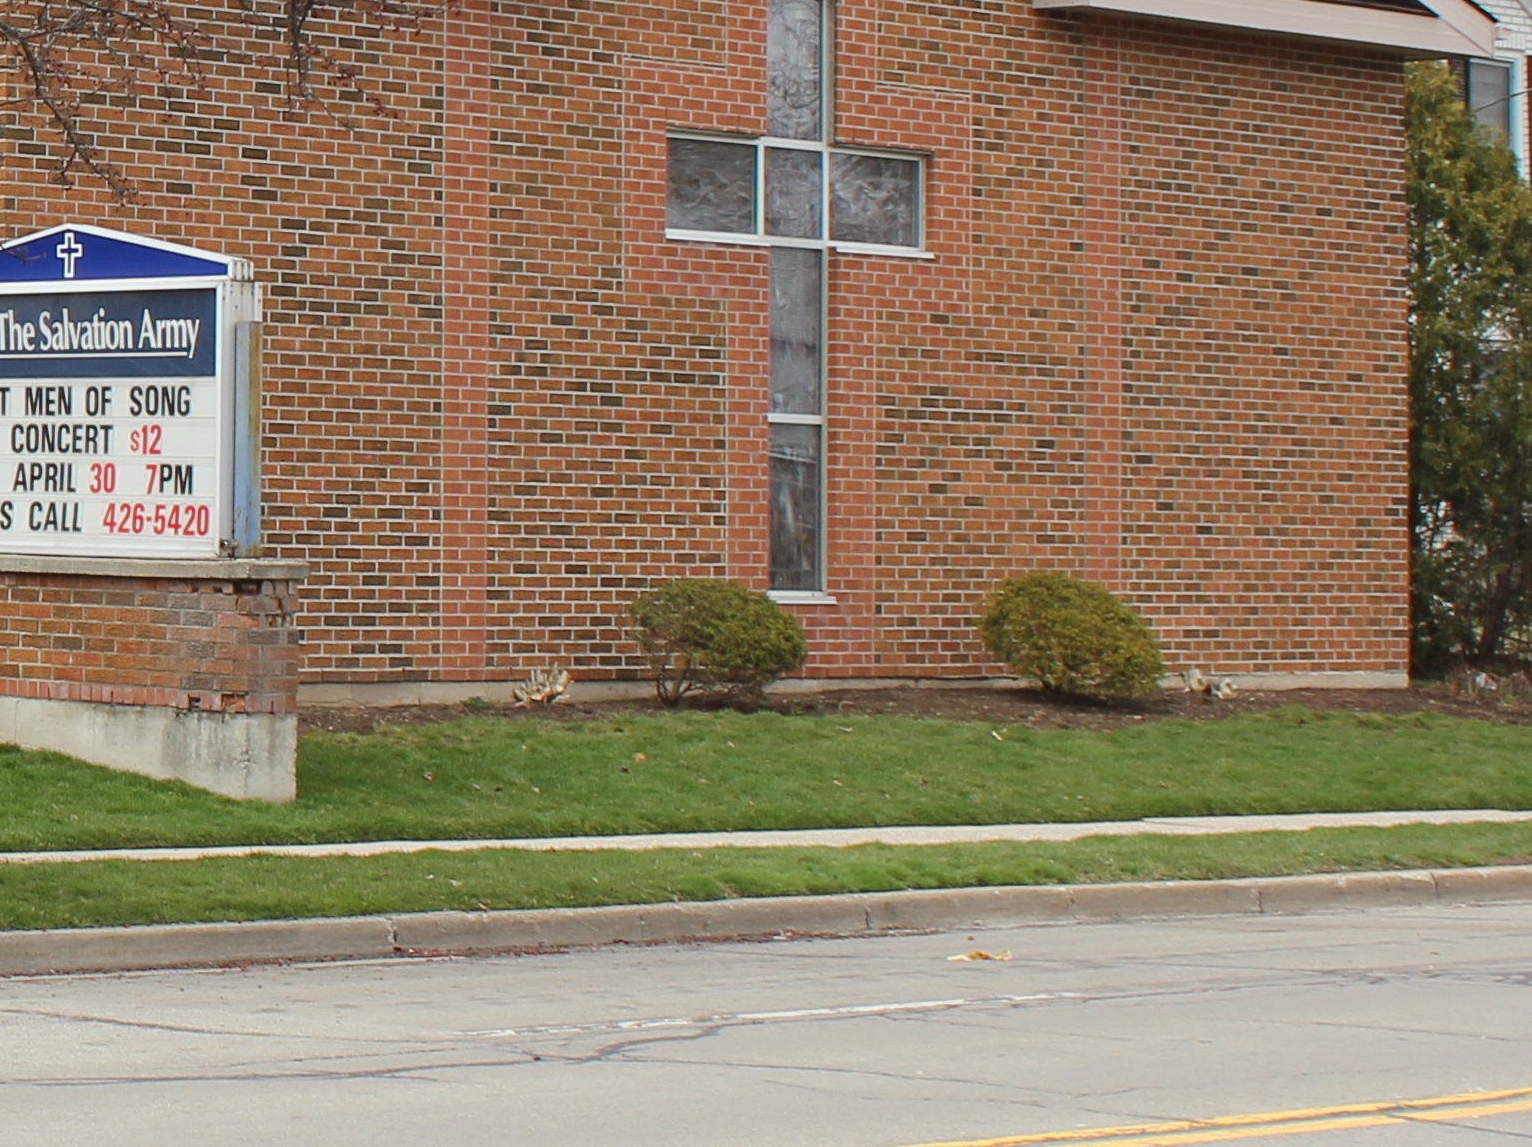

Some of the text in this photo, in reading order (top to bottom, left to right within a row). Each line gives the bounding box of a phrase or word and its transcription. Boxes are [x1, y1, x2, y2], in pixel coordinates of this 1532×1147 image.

[39, 307, 134, 352] Salvation
[137, 308, 201, 359] Army
[24, 386, 73, 417] MEN
[85, 386, 113, 417] OF
[129, 385, 192, 417] SONG
[10, 423, 114, 454] CONCERT
[129, 424, 163, 455] $12
[12, 461, 77, 494] APRIL
[89, 462, 118, 494] 30
[145, 463, 194, 496] 7PM
[28, 500, 83, 533] CALL
[102, 502, 210, 536] 426-5420
